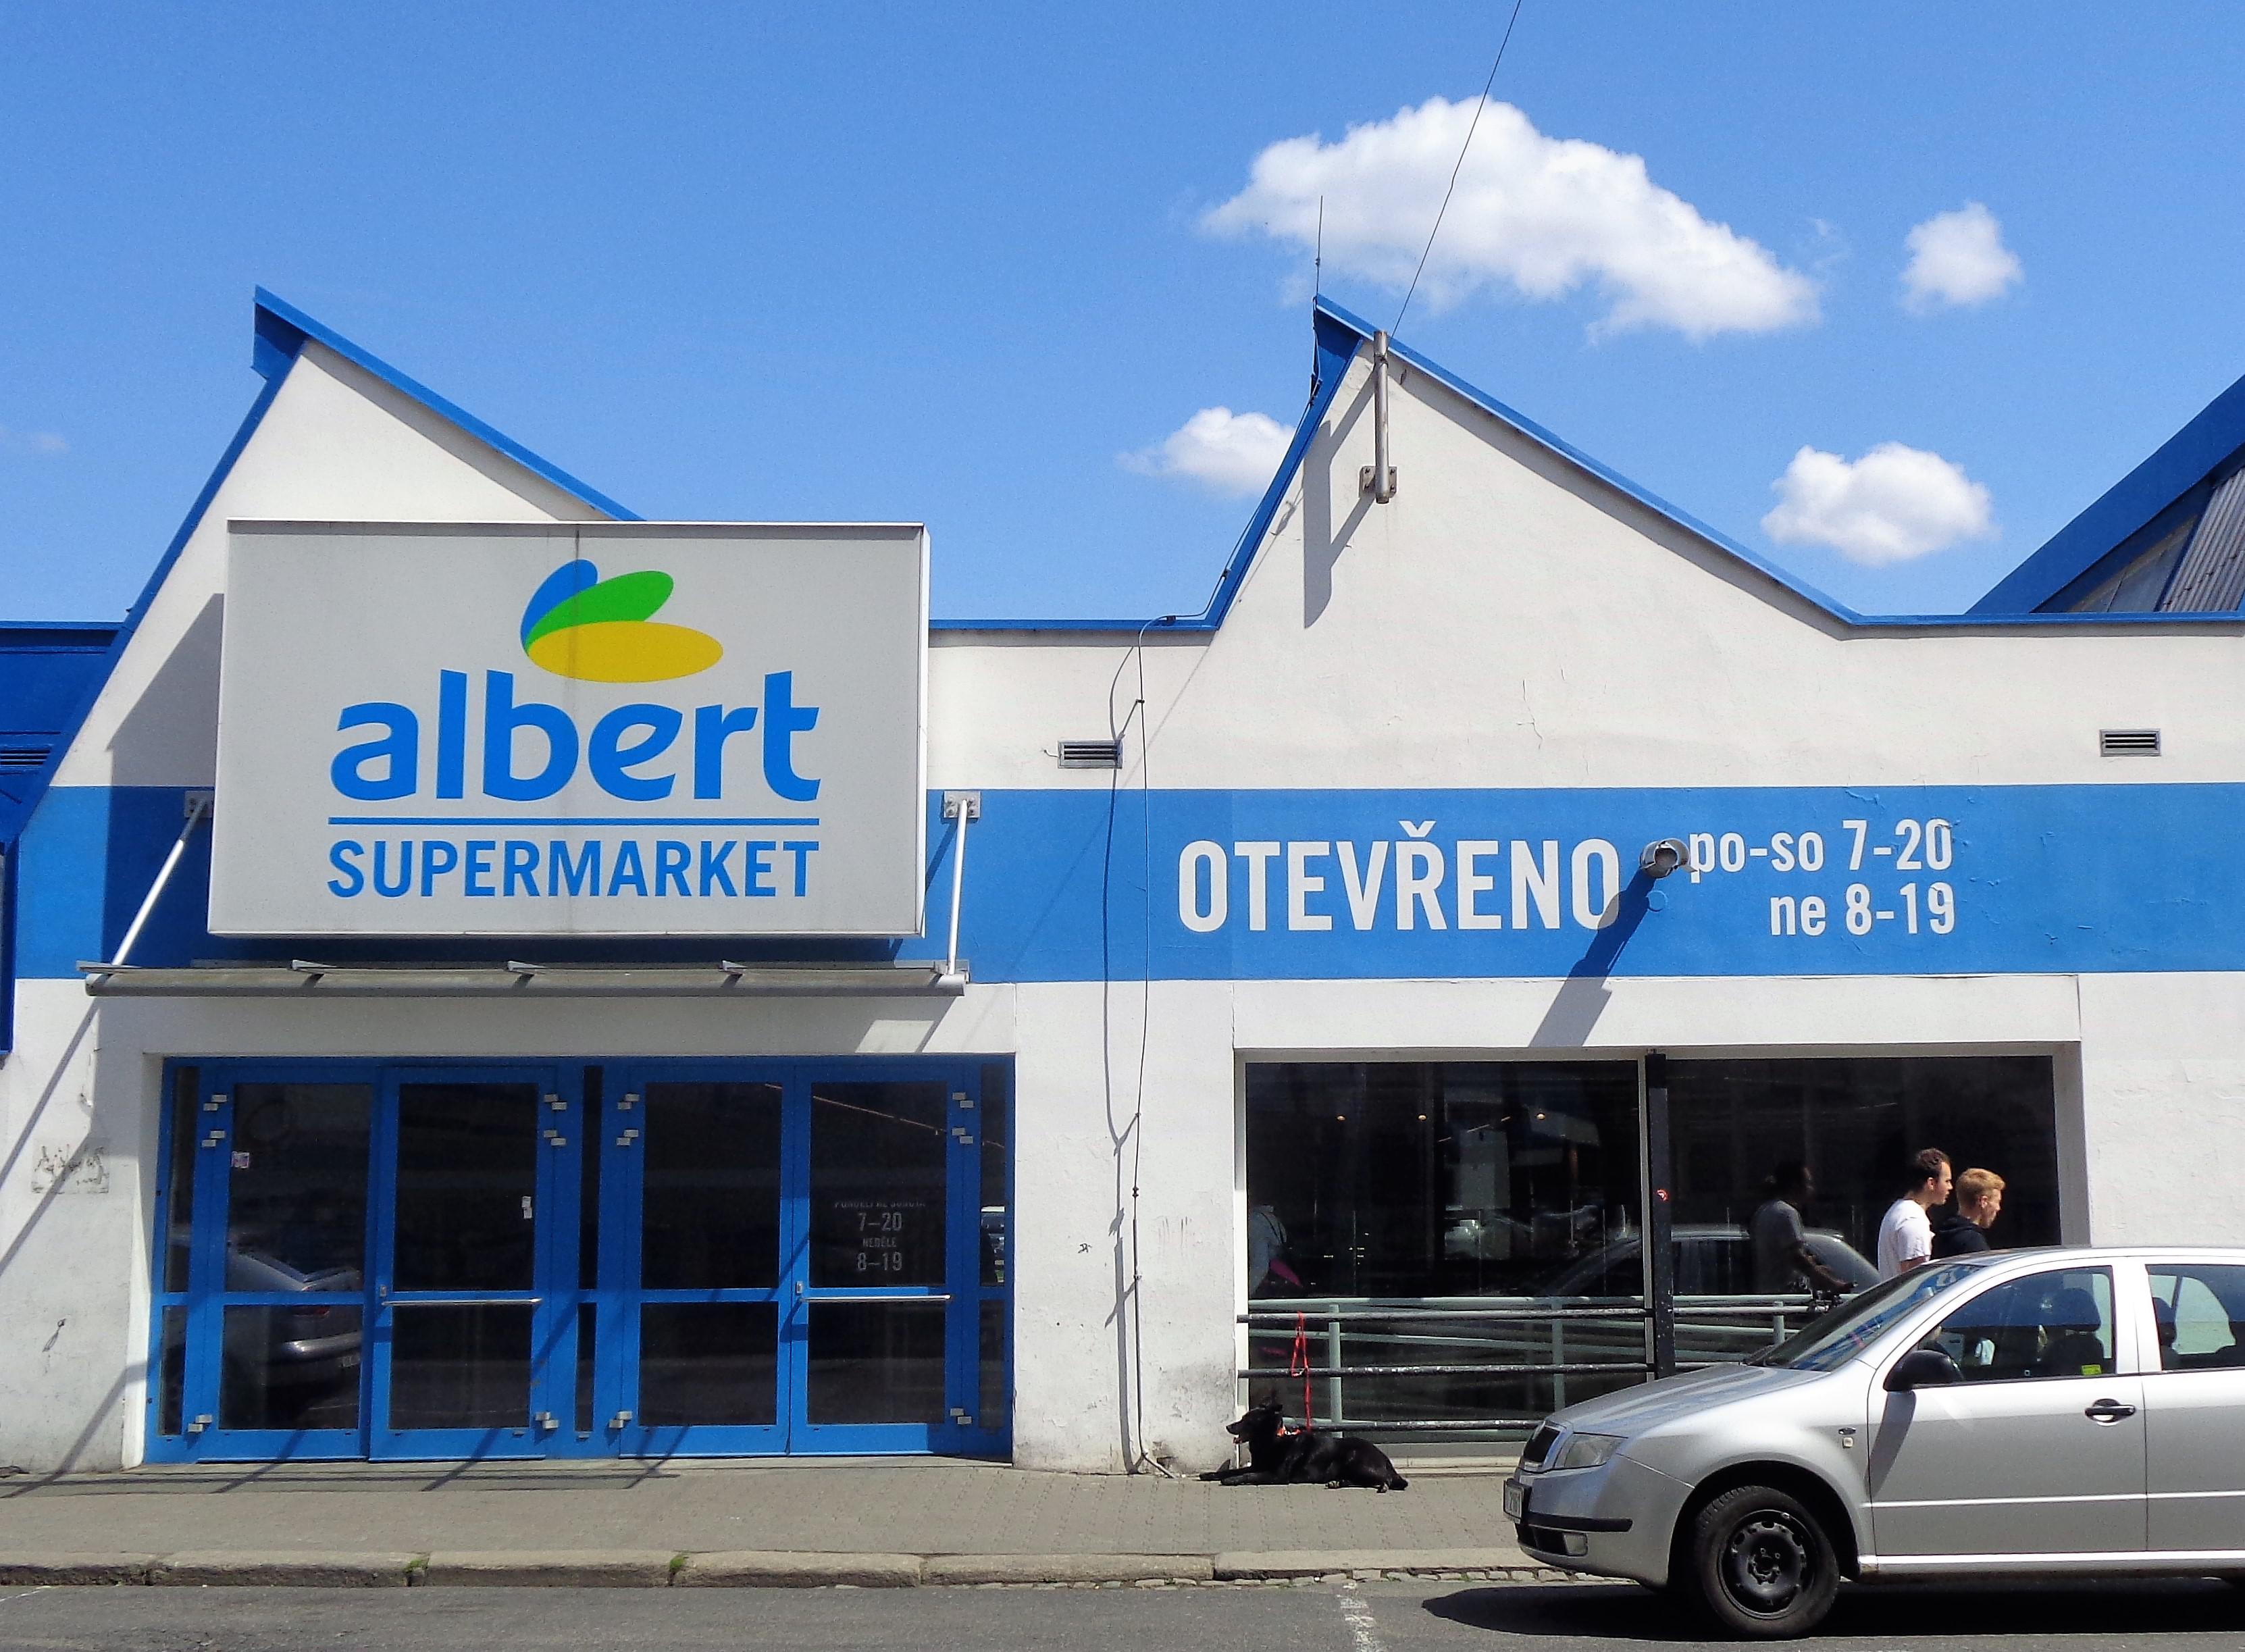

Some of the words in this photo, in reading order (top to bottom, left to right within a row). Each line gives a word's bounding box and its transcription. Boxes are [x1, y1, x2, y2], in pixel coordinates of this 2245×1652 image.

[330, 669, 821, 802] albert
[328, 840, 819, 897] SUPERMARKET
[1179, 820, 1620, 932] OTEVŘENO
[1689, 831, 1824, 884] po-so
[1842, 819, 1953, 871] 7-20
[1770, 896, 1826, 937] ne
[1845, 881, 1955, 936] 8-19
